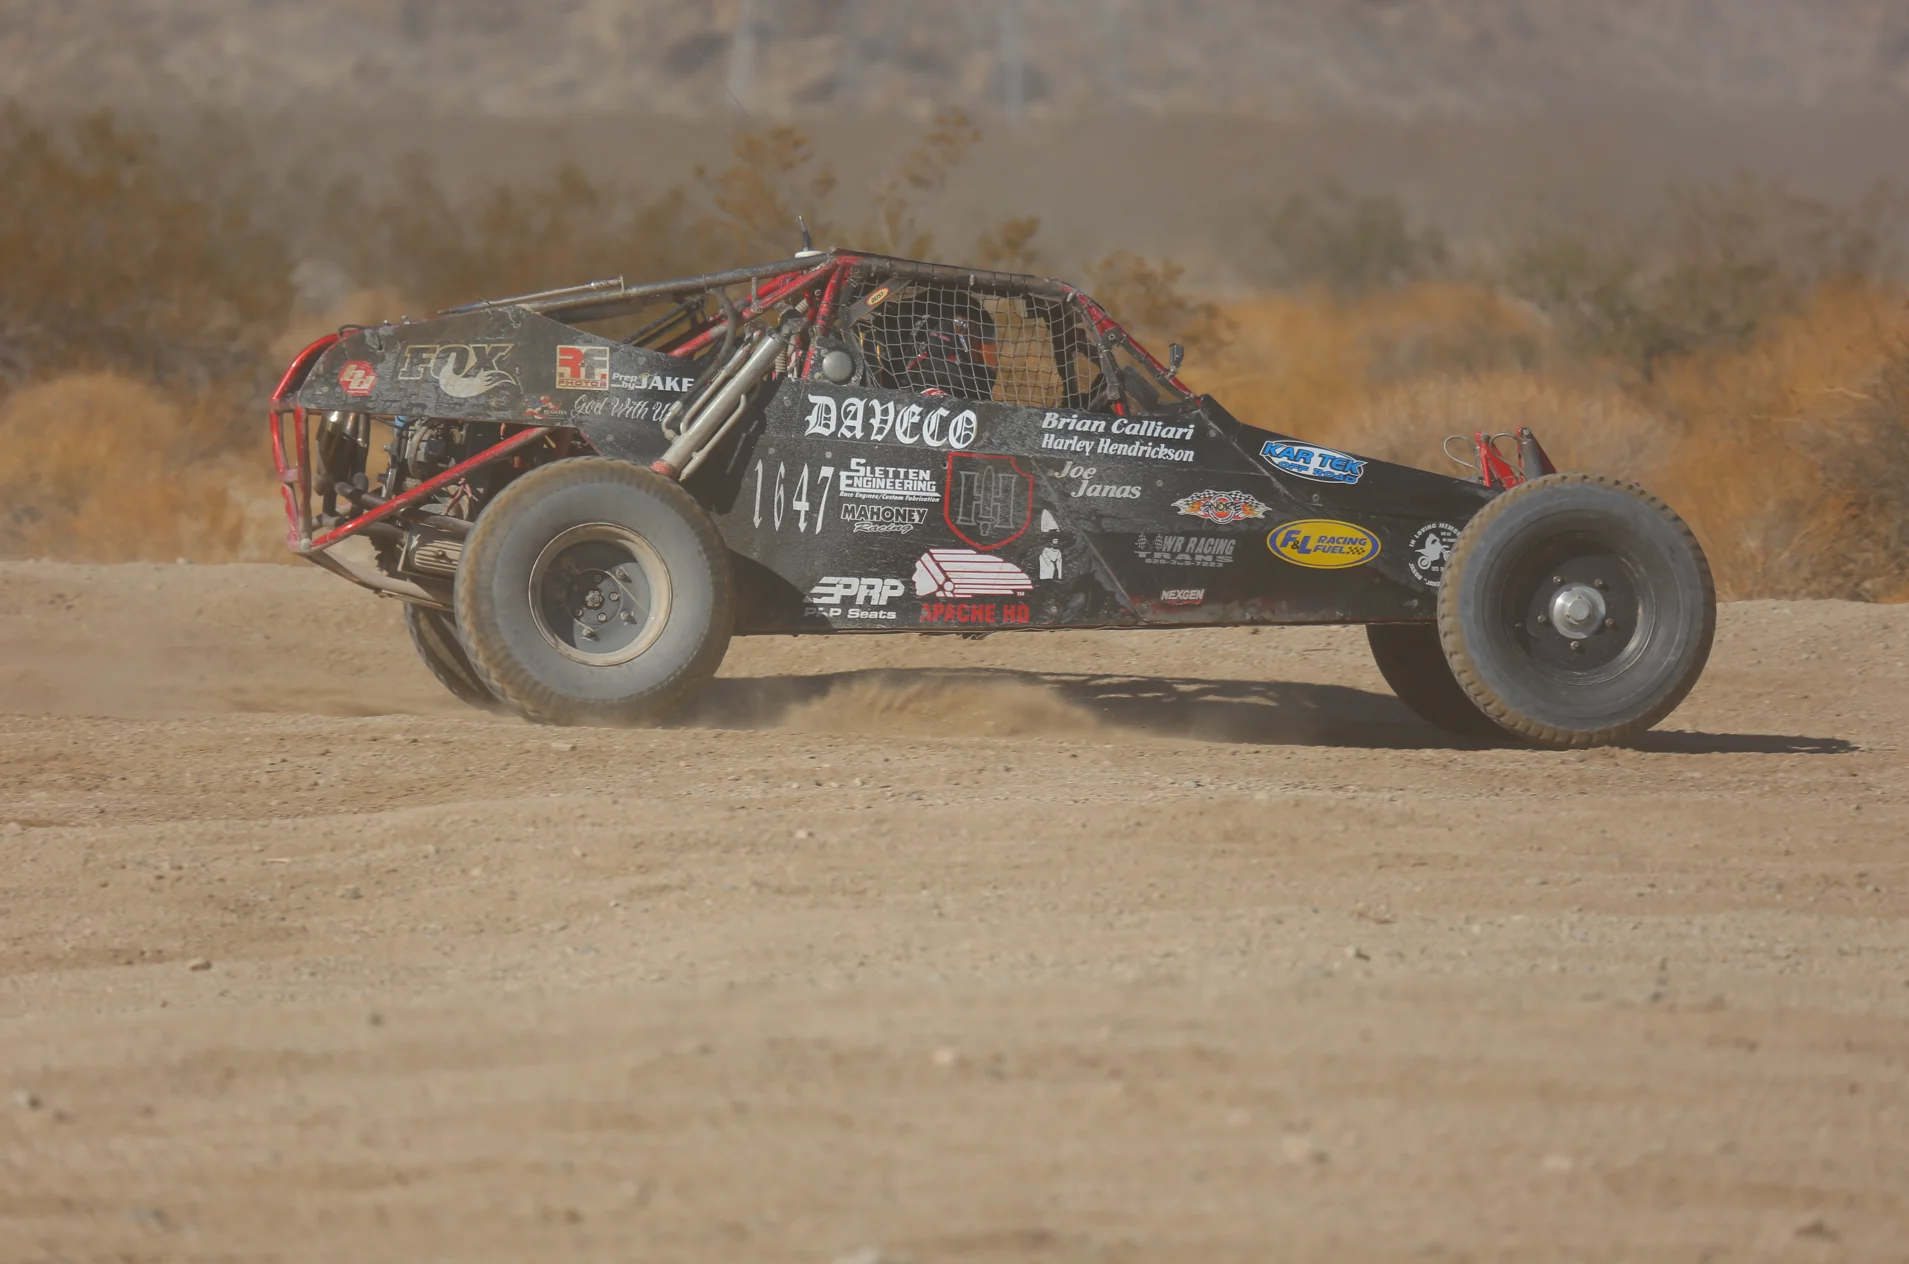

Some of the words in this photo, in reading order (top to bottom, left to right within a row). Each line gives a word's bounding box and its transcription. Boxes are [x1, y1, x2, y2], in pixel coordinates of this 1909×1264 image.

[398, 344, 515, 393] FOX
[612, 373, 638, 382] Prep
[621, 380, 636, 391] by
[570, 394, 605, 419] God
[610, 397, 650, 420] With
[652, 401, 671, 422] U
[804, 393, 978, 449] DAVECO
[1041, 412, 1106, 433] Brian
[1111, 418, 1195, 440] Calliari
[1041, 434, 1094, 456] Harley
[1097, 438, 1195, 462] Hendrickson
[850, 458, 931, 480] SLETTEN
[1263, 443, 1314, 464] KAR
[1319, 453, 1362, 475] TEK
[1054, 461, 1097, 480] Joe
[1278, 461, 1309, 472] OFF
[1313, 468, 1357, 484] ROAD
[839, 471, 937, 492] ENGINEERING
[1070, 480, 1142, 499] Janas
[753, 459, 835, 535] 1647
[905, 495, 941, 503] Fabrication
[840, 503, 929, 525] MAHONEY
[1202, 501, 1242, 514] SNORE
[853, 522, 914, 535] Racing
[1408, 538, 1417, 547] IN
[1414, 523, 1437, 539] LOVING
[1162, 535, 1185, 552] WR
[1186, 537, 1236, 555] RACING
[1280, 530, 1312, 554] F&L
[1317, 535, 1367, 546] RACING
[1313, 545, 1345, 554] FUEL
[1133, 550, 1234, 563] TRANS
[1408, 562, 1423, 580] JASON
[809, 576, 905, 606] PRP
[1161, 589, 1205, 600] NEXGEN
[847, 608, 897, 619] Seats
[919, 603, 997, 623] APACHE
[1003, 604, 1030, 623] HD
